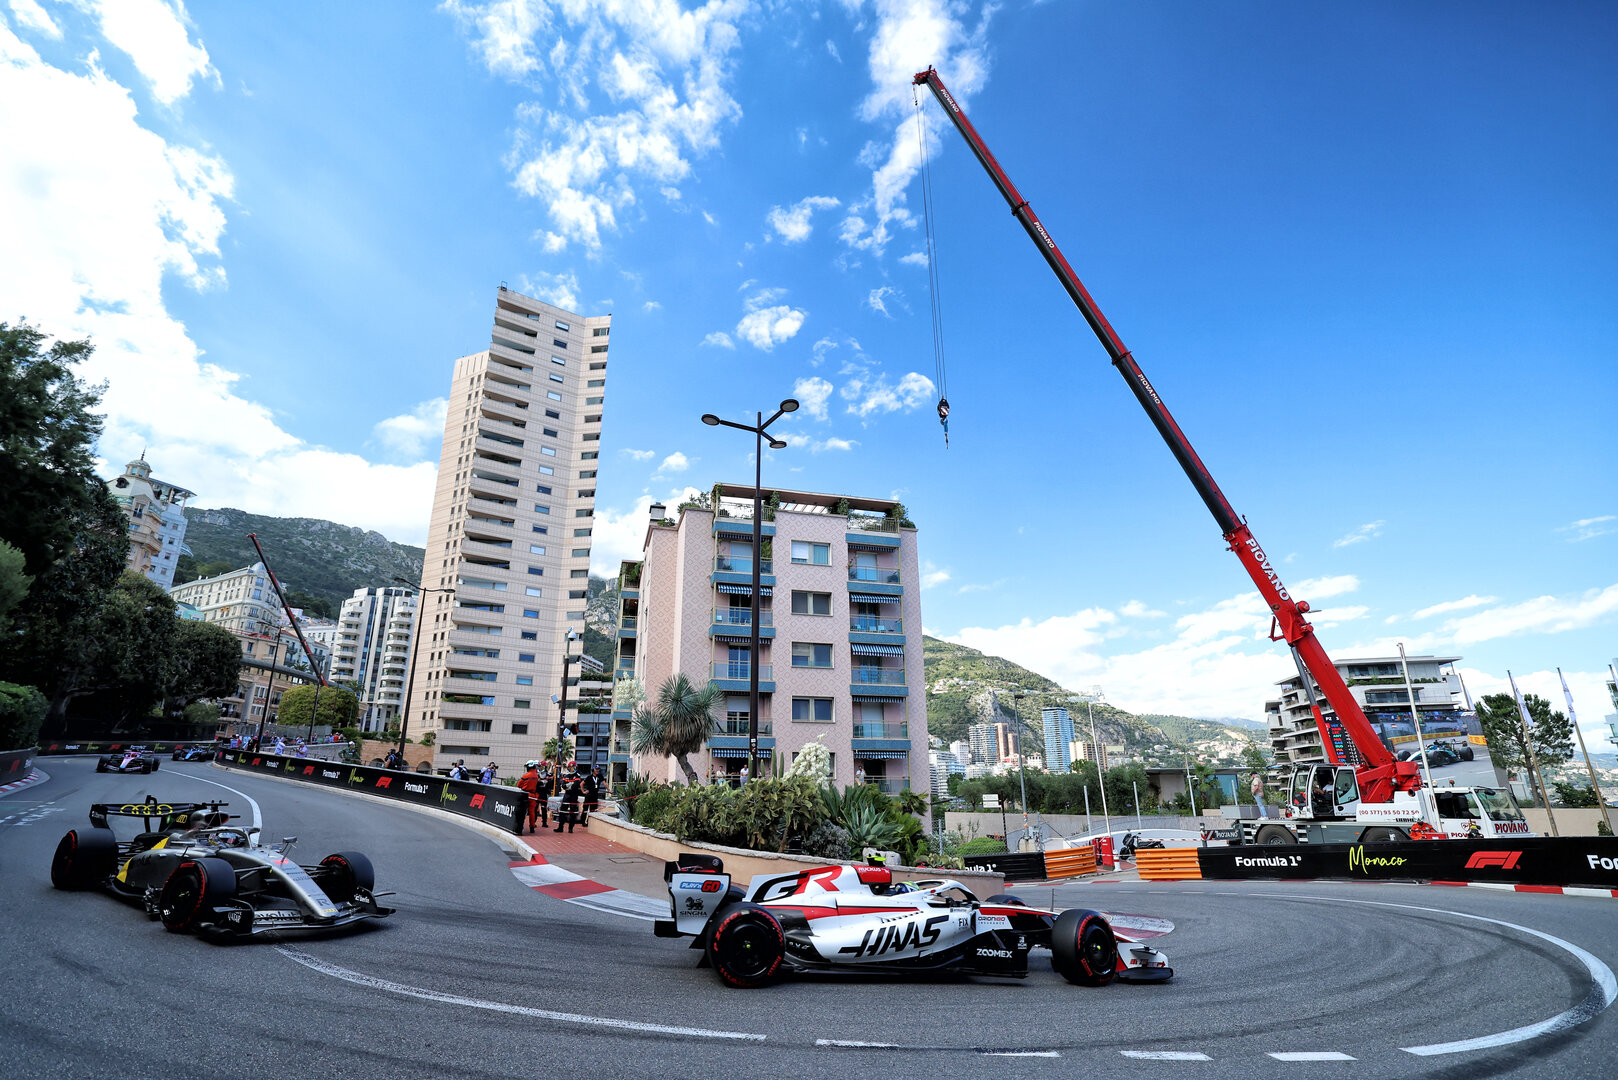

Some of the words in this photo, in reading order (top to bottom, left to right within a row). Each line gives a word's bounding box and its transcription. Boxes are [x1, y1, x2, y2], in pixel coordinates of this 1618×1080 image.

[1033, 221, 1055, 249] PIOVANO
[1137, 373, 1161, 404] PIOVANO
[1245, 538, 1290, 601] PIOVANO
[404, 782, 423, 793] Formula
[469, 793, 486, 809] F1
[494, 801, 510, 816] Formula
[1494, 822, 1529, 834] PIOVANO
[1235, 856, 1288, 867] Formula
[1350, 844, 1408, 875] Monaco
[1463, 850, 1523, 870] F1
[702, 880, 721, 892] GO
[958, 918, 969, 928] FIX
[838, 915, 950, 959] HAAS
[976, 948, 1013, 959] ZOOMEX
